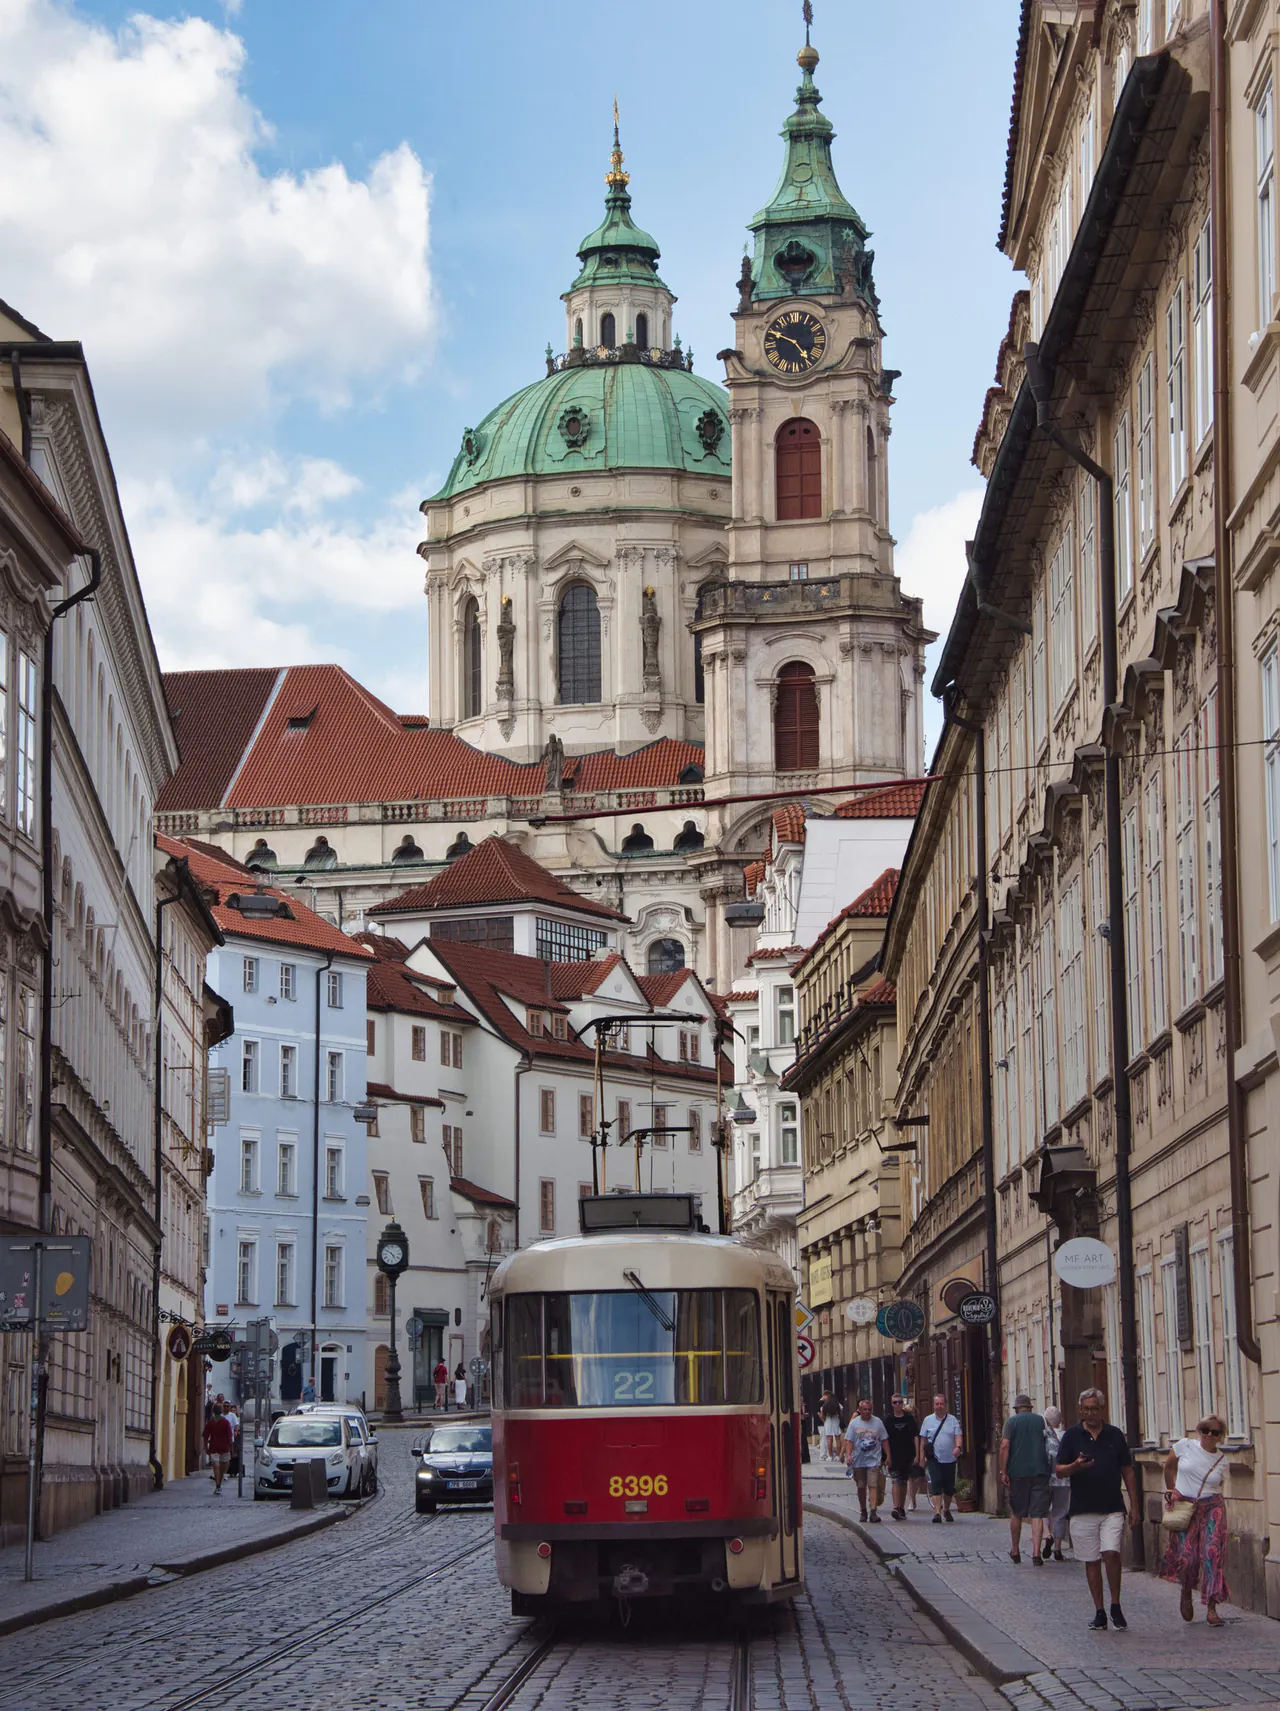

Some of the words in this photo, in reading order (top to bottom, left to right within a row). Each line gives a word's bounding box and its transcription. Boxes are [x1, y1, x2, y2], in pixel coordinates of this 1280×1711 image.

[1065, 1254, 1079, 1263] MF
[1084, 1253, 1104, 1263] ART
[614, 1371, 654, 1399] 22
[609, 1475, 668, 1497] 8396
